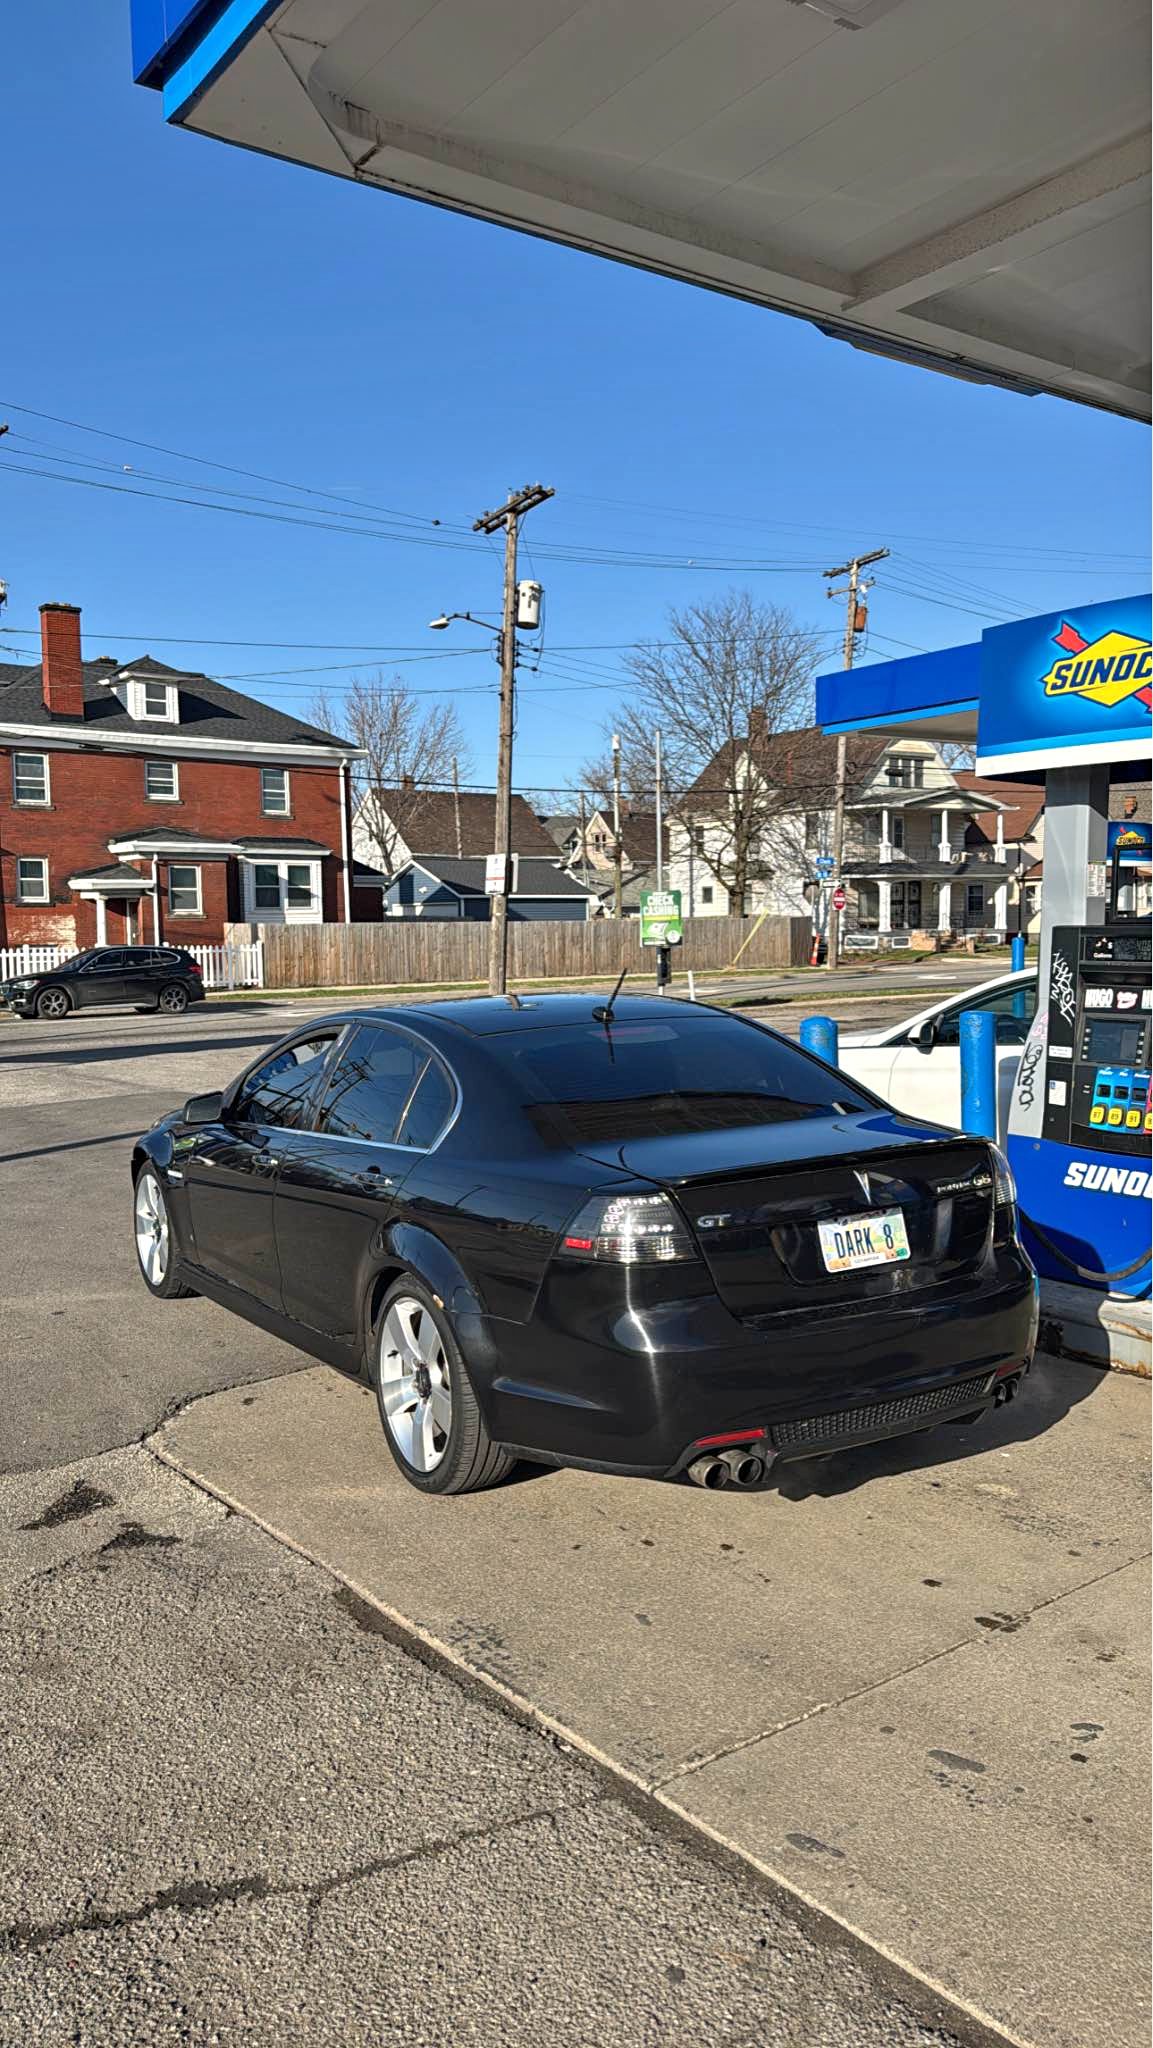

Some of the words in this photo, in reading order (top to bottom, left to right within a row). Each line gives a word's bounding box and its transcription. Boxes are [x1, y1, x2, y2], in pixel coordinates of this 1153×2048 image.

[1050, 651, 1152, 691] SUNOC
[647, 895, 674, 905] CHECK
[643, 905, 679, 916] CASHING
[697, 1213, 732, 1228] GT
[834, 1227, 876, 1259] DARK
[883, 1223, 894, 1250] 8
